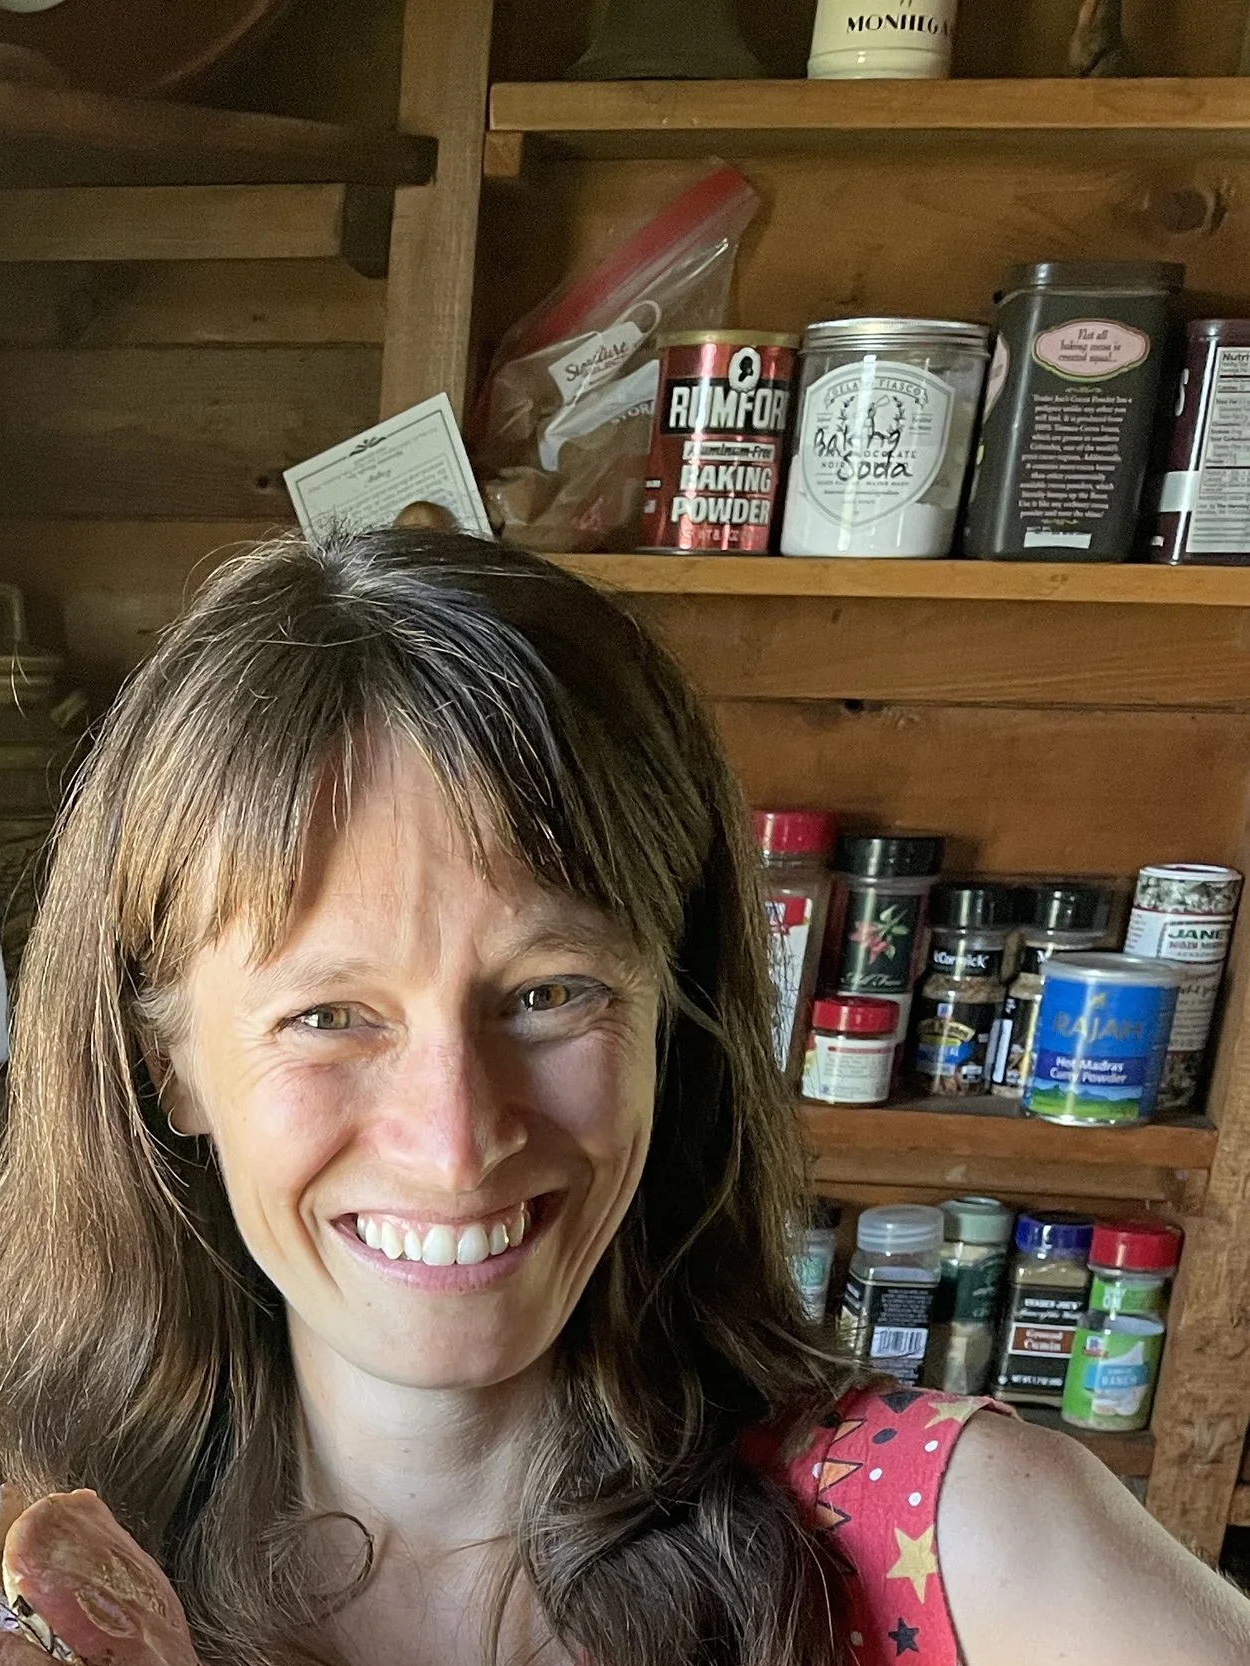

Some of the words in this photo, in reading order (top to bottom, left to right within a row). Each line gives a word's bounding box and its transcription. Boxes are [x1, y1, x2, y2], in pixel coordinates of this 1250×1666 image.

[879, 379, 922, 396] FIASCO
[814, 425, 901, 458] Bakng
[680, 464, 772, 492] BAKING
[837, 449, 914, 481] Soda
[671, 497, 771, 525] POWDER
[1053, 1012, 1145, 1043] RAJAH
[1080, 1059, 1124, 1072] Madras
[1082, 1072, 1127, 1084] Powder
